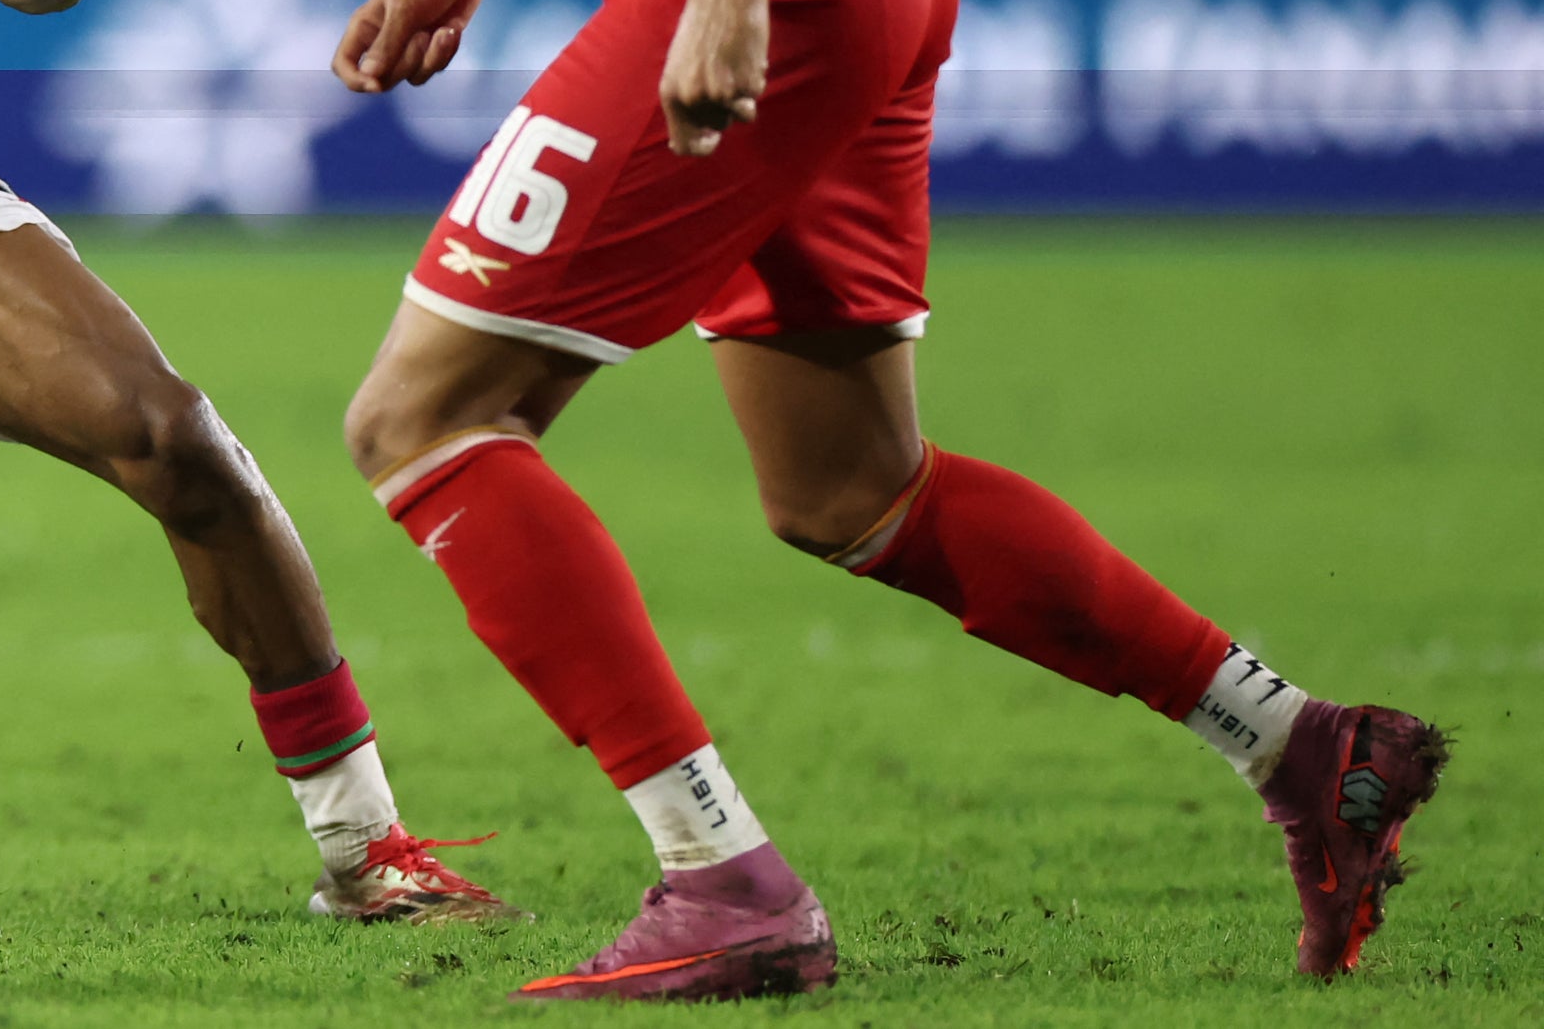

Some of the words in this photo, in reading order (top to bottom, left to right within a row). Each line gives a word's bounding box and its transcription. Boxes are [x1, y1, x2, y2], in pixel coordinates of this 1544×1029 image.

[448, 104, 599, 256] 16
[1195, 693, 1260, 750] LIGHT
[680, 758, 728, 829] LIGH
